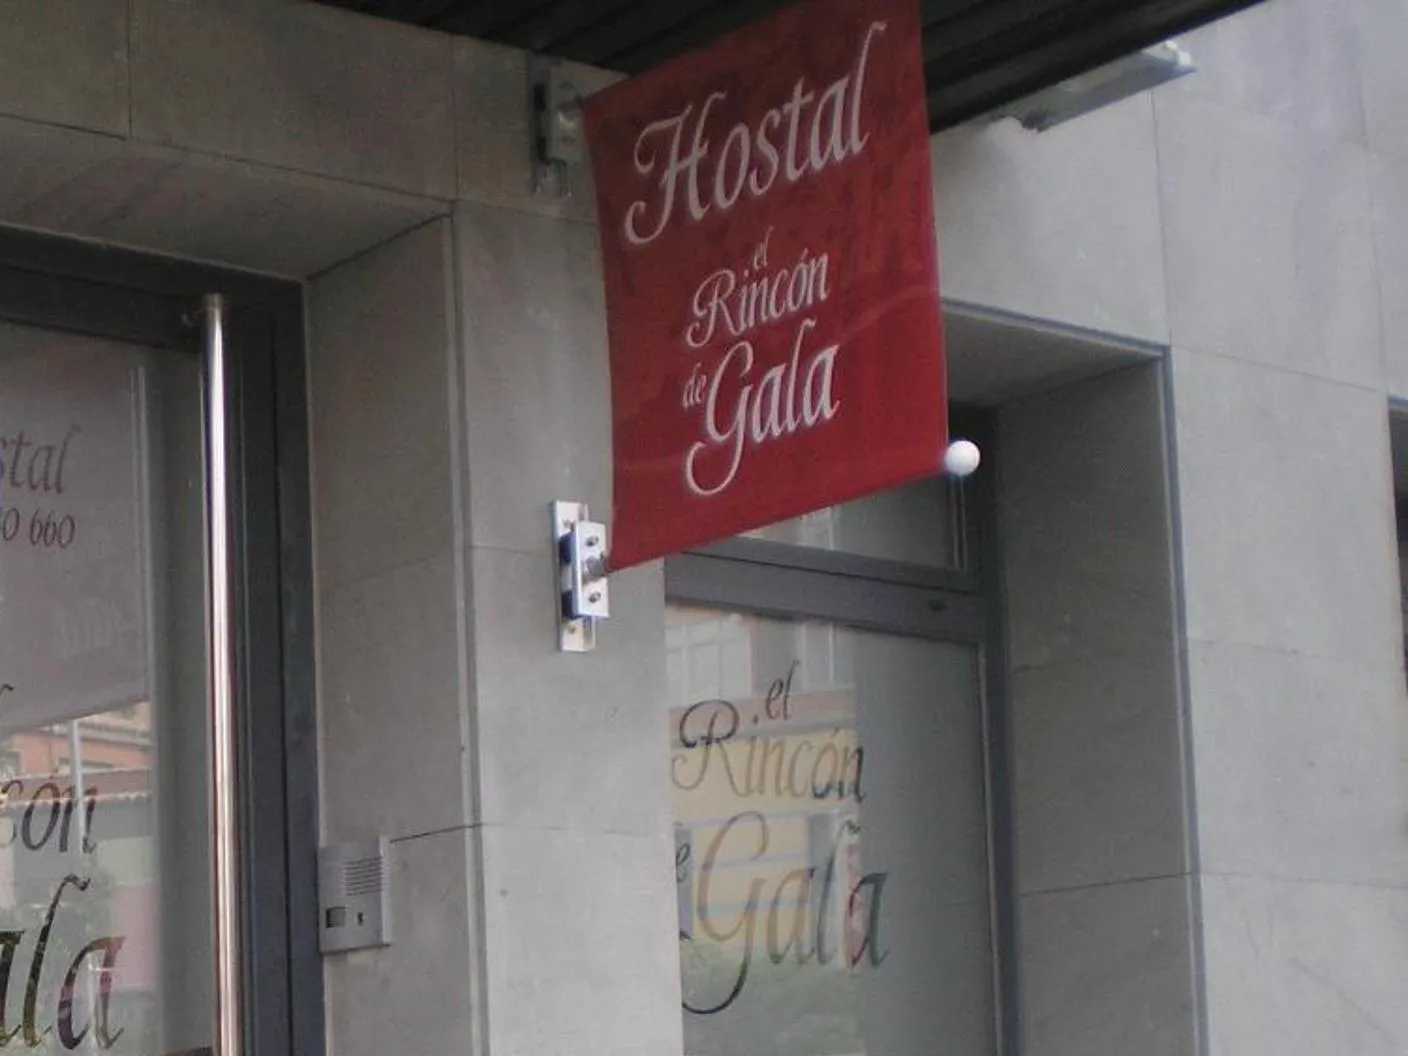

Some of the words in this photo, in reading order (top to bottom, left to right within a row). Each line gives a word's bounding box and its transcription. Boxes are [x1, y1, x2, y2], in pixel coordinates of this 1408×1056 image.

[623, 20, 887, 246] Hostal
[685, 247, 831, 348] Rincón
[753, 226, 775, 270] el
[682, 361, 707, 409] de
[685, 319, 841, 496] Gala
[29, 508, 76, 549] 660
[765, 659, 800, 721] el
[671, 698, 867, 804] Rincón
[680, 810, 890, 1015] Gala
